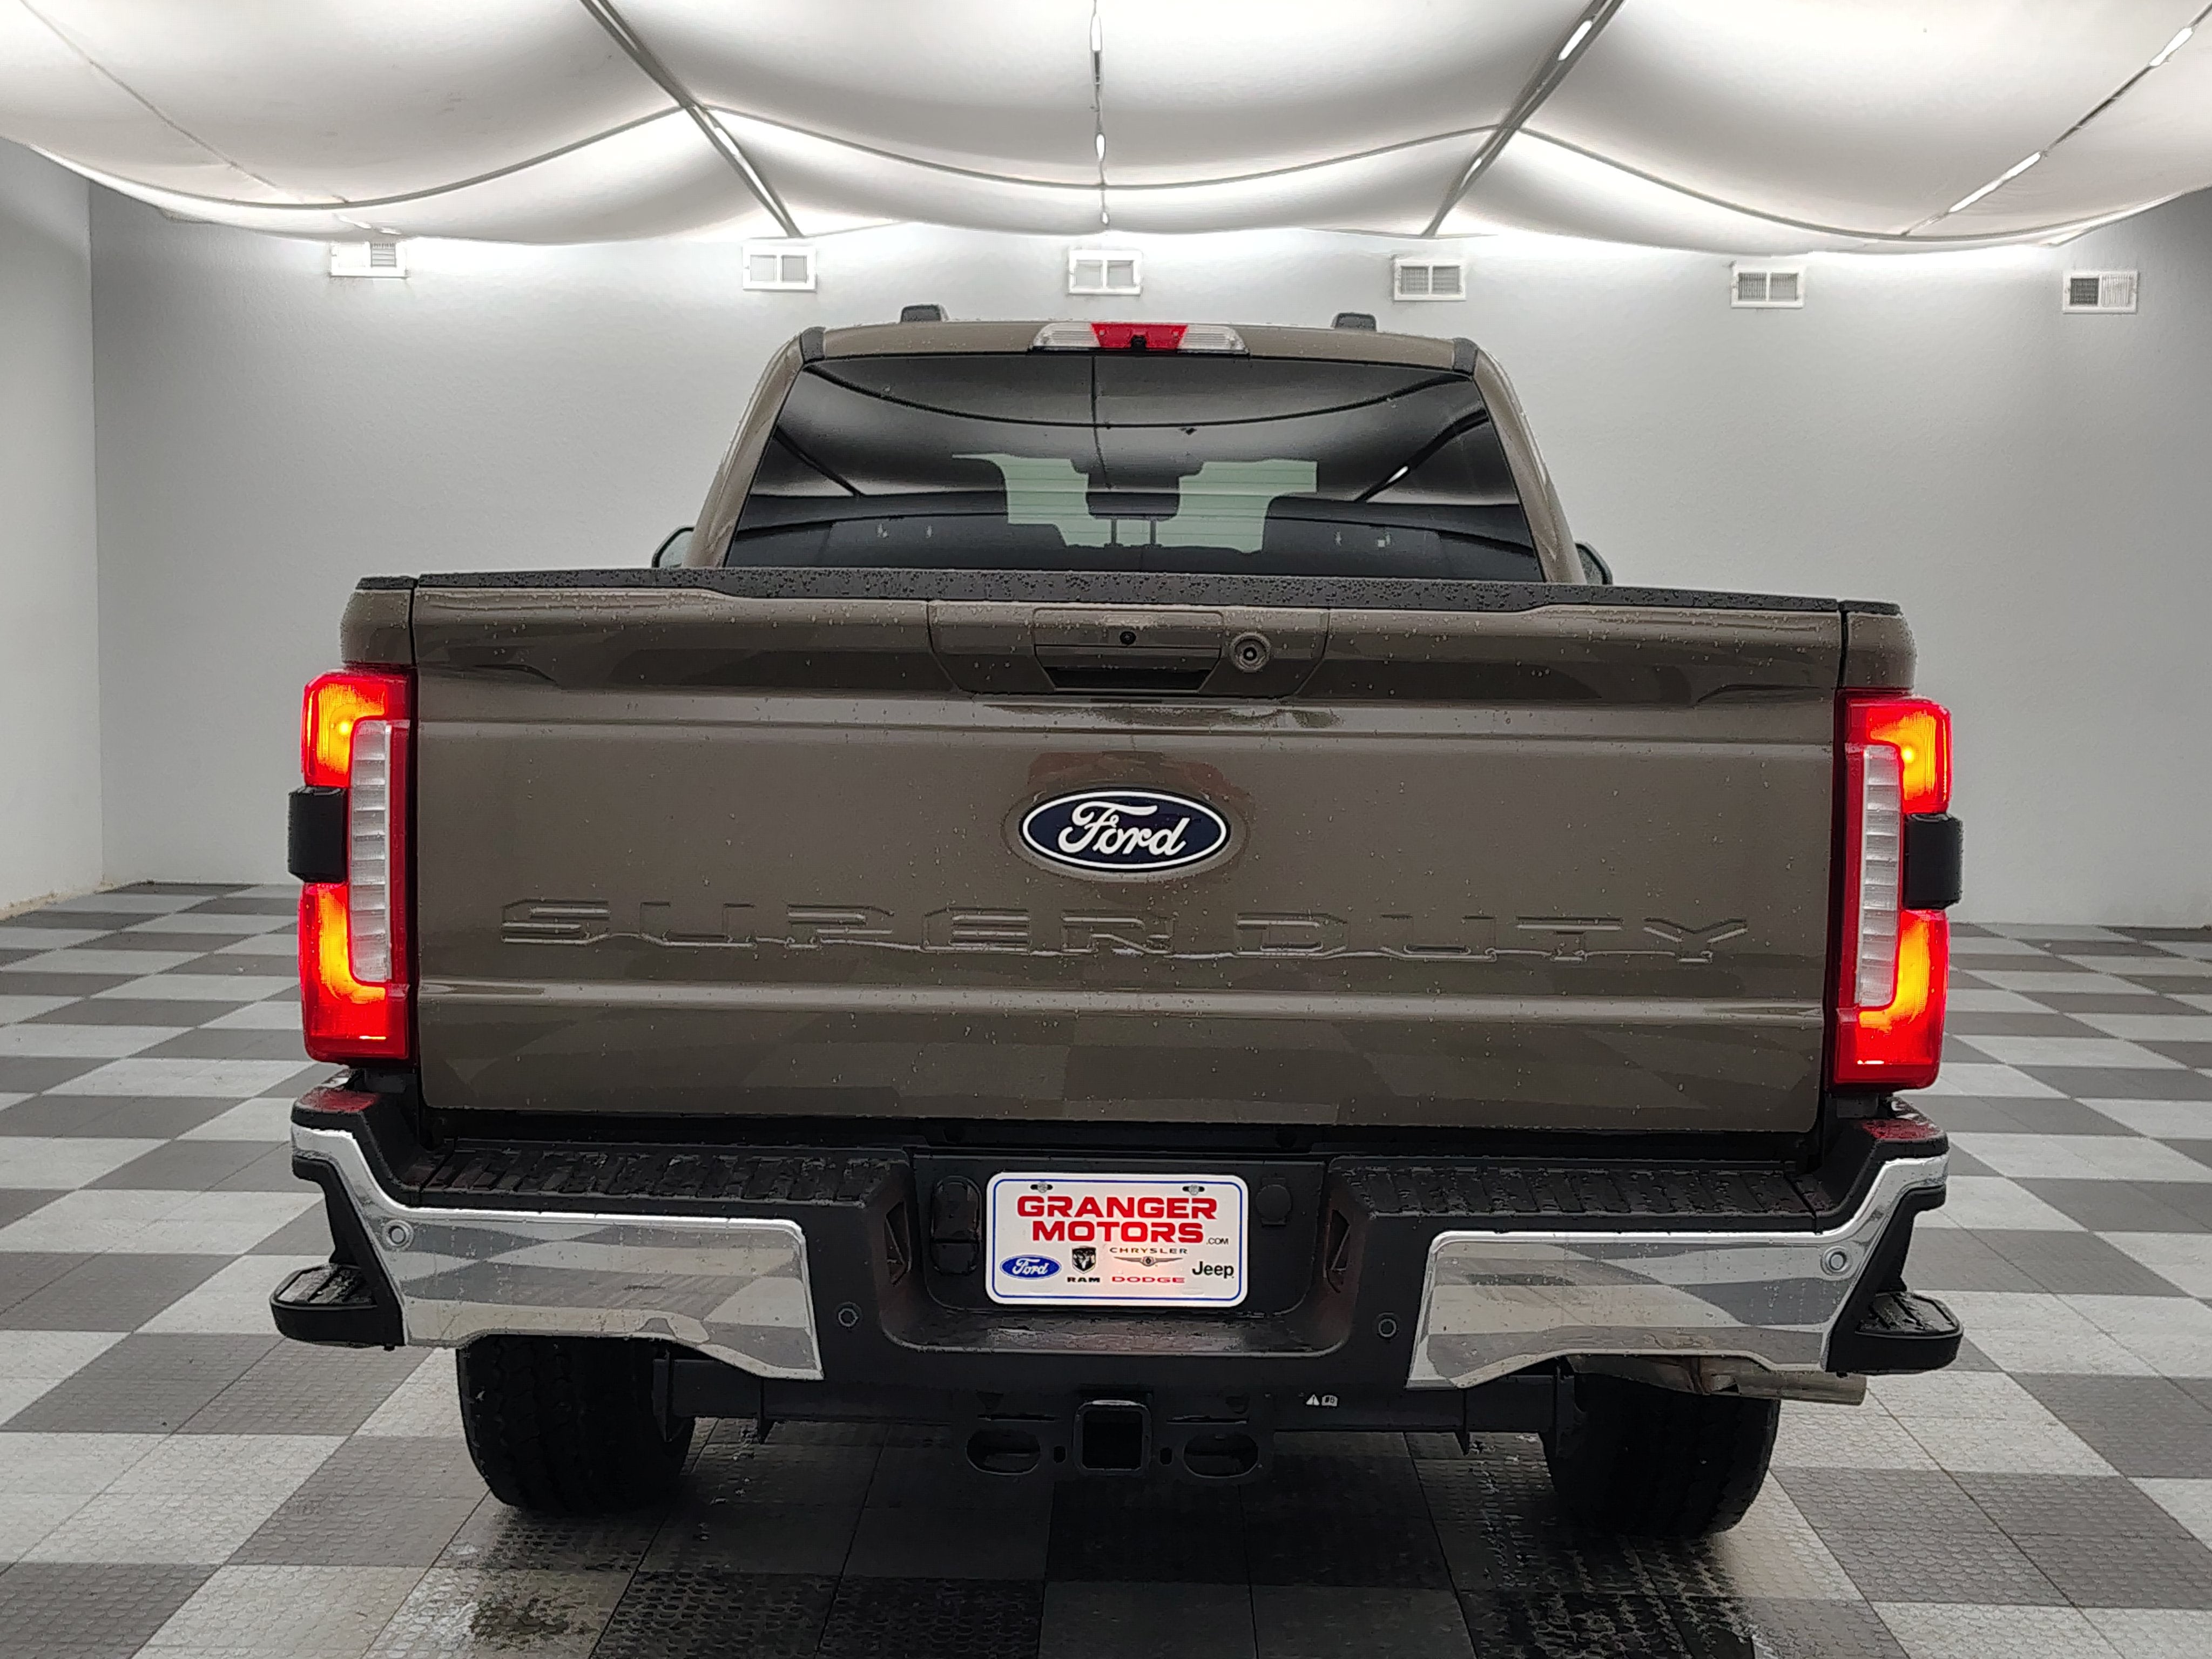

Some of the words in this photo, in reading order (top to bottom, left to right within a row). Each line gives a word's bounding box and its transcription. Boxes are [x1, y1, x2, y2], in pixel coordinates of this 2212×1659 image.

[1057, 800, 1191, 856] Ford
[502, 900, 1175, 956] SUPER
[1235, 912, 1748, 963] DUTY
[1017, 1196, 1217, 1219] GRANGER
[1032, 1220, 1204, 1243] MOTORS
[1012, 1258, 1048, 1276] Ford
[1192, 1260, 1234, 1279] Jeep
